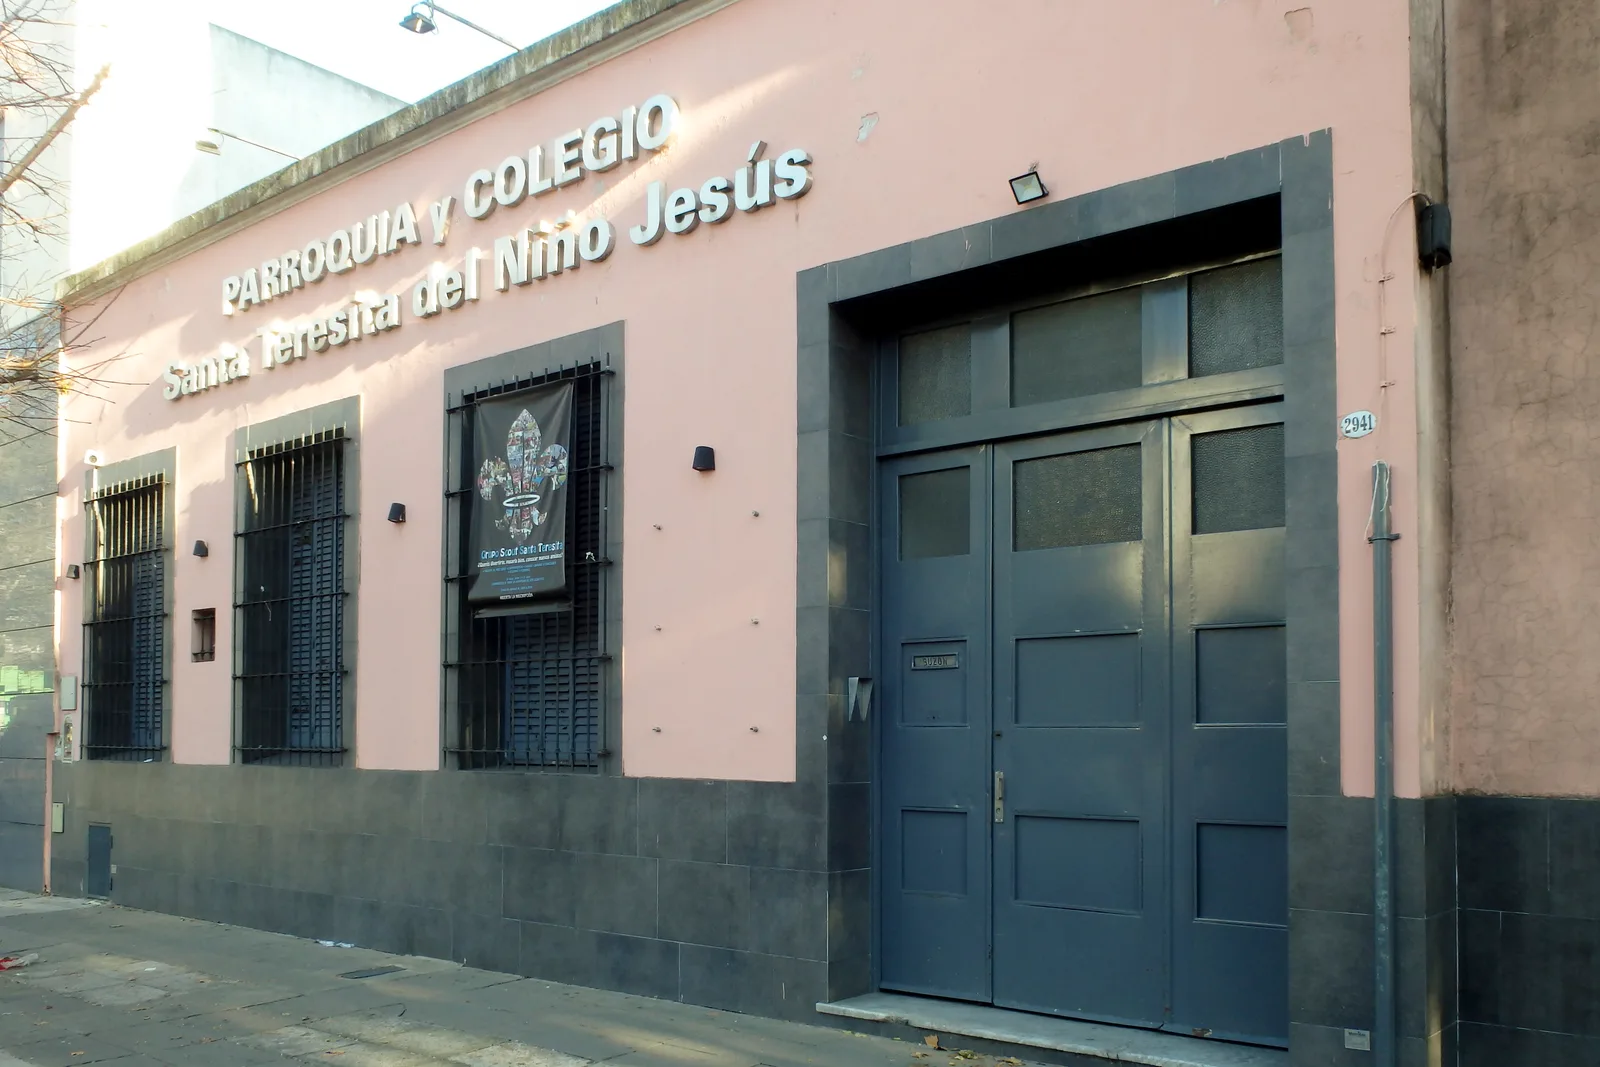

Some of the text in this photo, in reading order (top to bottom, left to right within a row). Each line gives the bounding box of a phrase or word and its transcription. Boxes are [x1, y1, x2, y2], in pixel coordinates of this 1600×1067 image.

[223, 202, 421, 316] PARROQUIA
[464, 94, 681, 220] COLEGIO
[163, 141, 812, 402] Santa Teresita del Niño Jesús
[1344, 414, 1372, 434] 2941
[500, 547, 518, 557] Scout
[519, 545, 537, 555] Santa
[538, 541, 563, 553] Teresita
